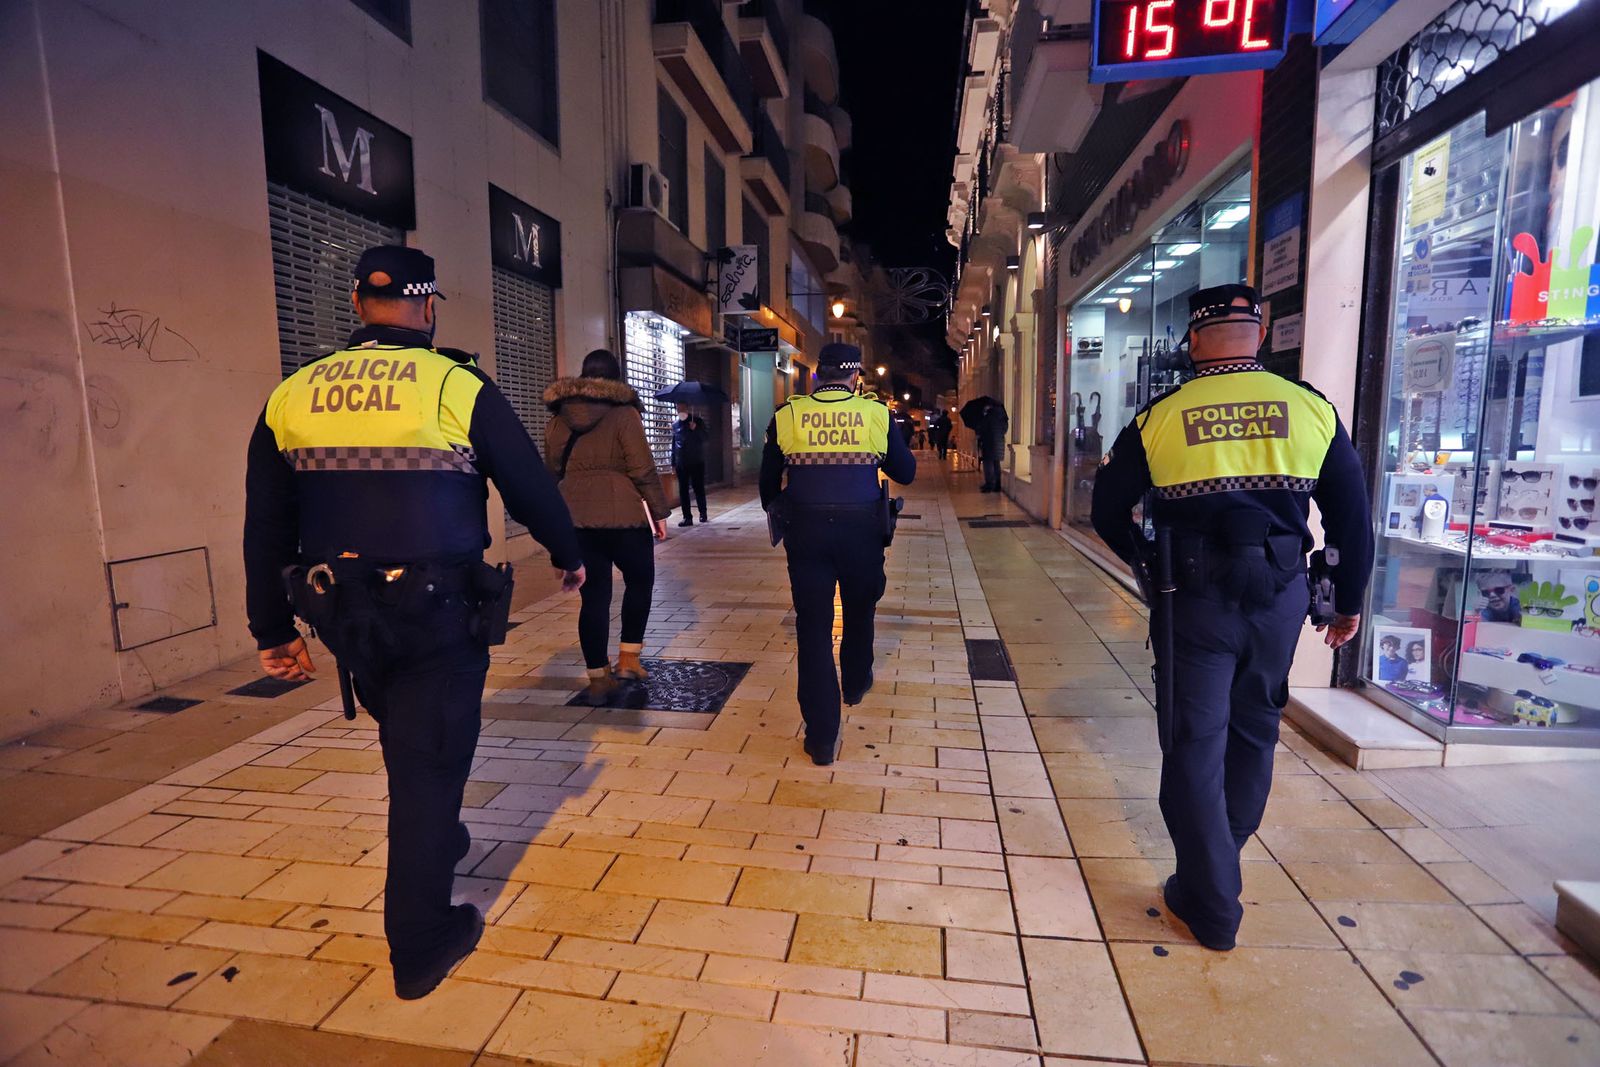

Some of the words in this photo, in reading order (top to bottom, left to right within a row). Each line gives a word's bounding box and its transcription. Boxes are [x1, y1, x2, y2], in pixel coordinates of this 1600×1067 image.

[1126, 0, 1174, 57] 15
[314, 103, 378, 195] M
[512, 212, 543, 269] M
[308, 358, 417, 384] POLICIA
[310, 383, 401, 413] LOCAL
[801, 411, 864, 429] POLICIA
[1186, 403, 1284, 426] POLICIA
[808, 429, 860, 447] LOCAL
[1197, 420, 1276, 441] LOCAL
